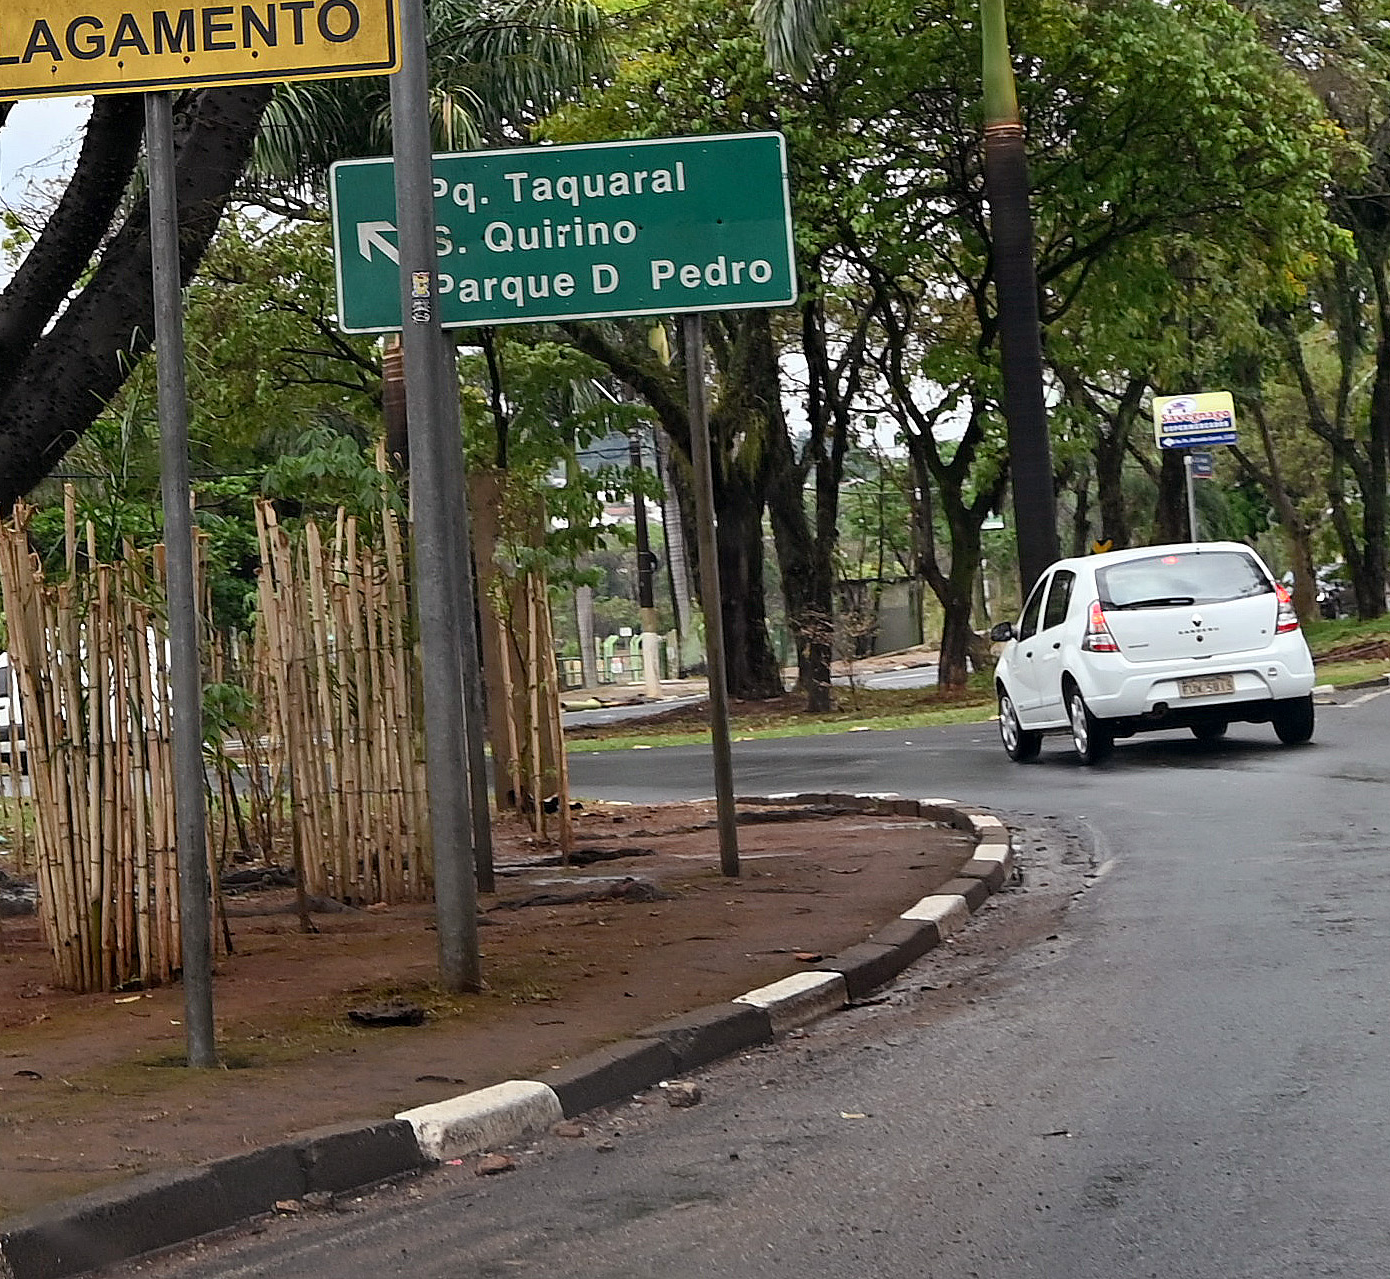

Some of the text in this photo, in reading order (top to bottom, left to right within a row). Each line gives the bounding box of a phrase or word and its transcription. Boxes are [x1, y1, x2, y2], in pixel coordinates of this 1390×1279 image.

[433, 161, 685, 214] Pq. Taquaral
[435, 216, 637, 257] S. Quirino
[437, 272, 575, 307] Parque
[591, 264, 620, 294] D
[650, 255, 772, 290] Pedro
